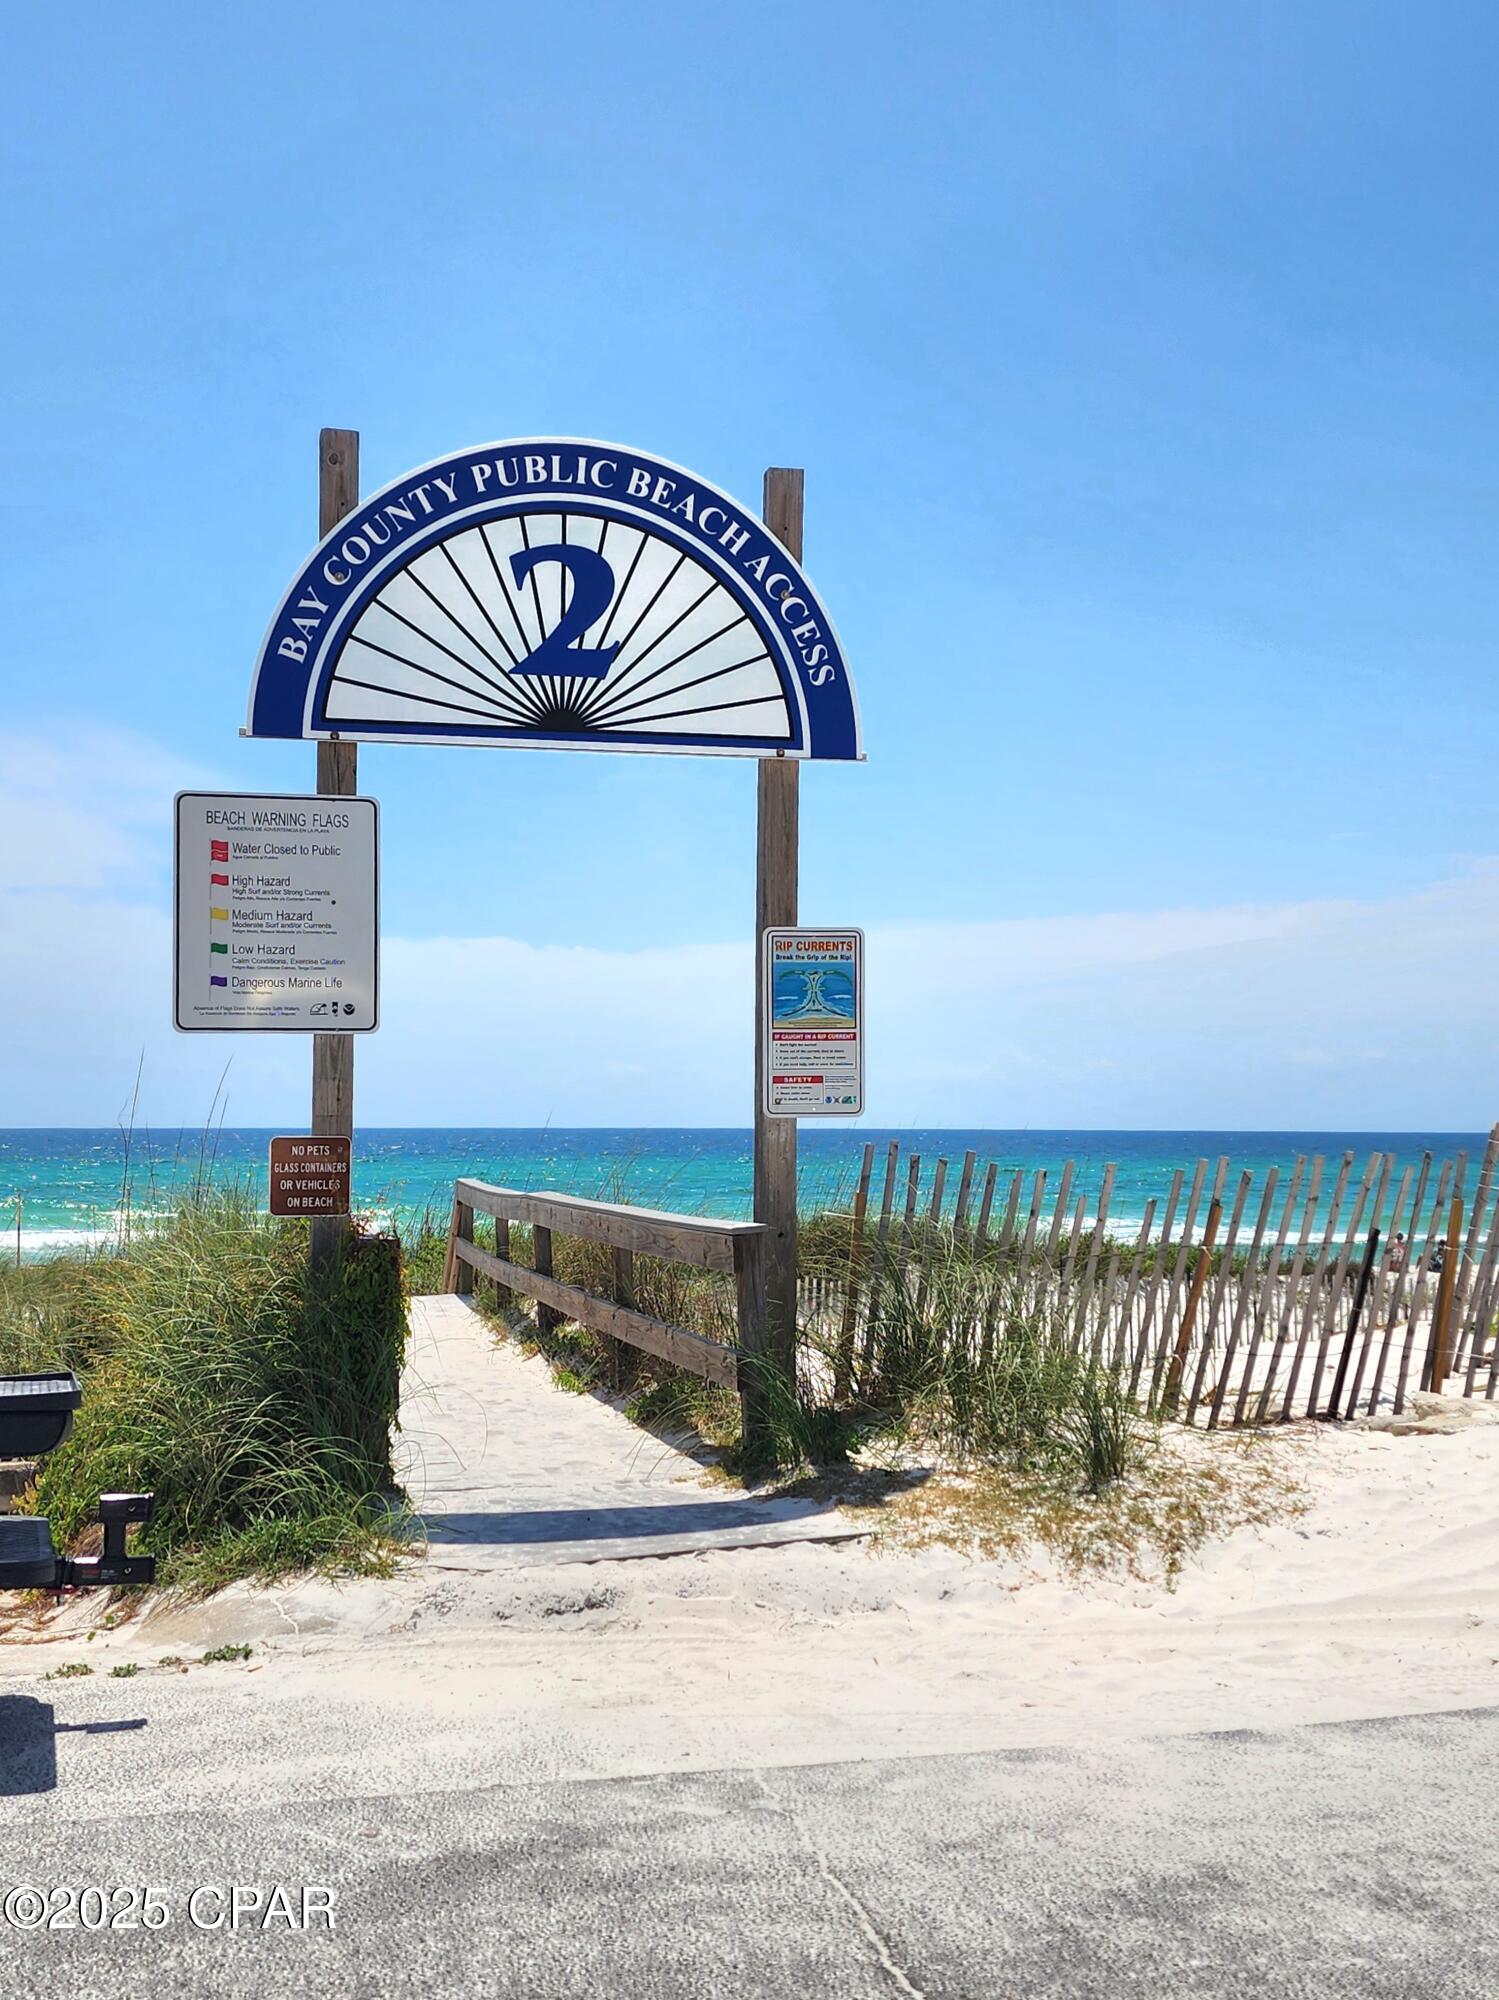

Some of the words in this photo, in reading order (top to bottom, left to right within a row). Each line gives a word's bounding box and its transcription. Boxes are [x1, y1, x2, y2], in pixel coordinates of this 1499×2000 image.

[277, 585, 330, 664] BAY
[323, 472, 458, 586] COUNTY
[471, 455, 617, 494] PUBLIC
[625, 467, 752, 556] BEACH
[743, 555, 836, 687] ACCESS
[508, 543, 620, 680] 2
[206, 810, 246, 825] BEACH
[251, 811, 307, 828] WARNING
[312, 813, 350, 829] FLAGS
[232, 842, 261, 855] Water
[263, 843, 297, 856] Closed
[300, 844, 309, 855] to
[312, 844, 342, 857] Public
[232, 875, 254, 889] High
[256, 875, 291, 887] Hazard
[232, 887, 247, 896] High
[283, 888, 303, 897] Strong
[232, 909, 273, 921] Medium
[276, 910, 313, 922] Hazard
[232, 921, 264, 929] Moderate
[280, 922, 302, 930] and/or
[303, 922, 332, 930] Currents
[232, 943, 254, 955] Low
[257, 944, 296, 955] Hazard
[775, 940, 793, 952] RIP
[796, 940, 853, 952] CURRENTS
[319, 958, 346, 966] Caution
[231, 976, 286, 991] Dangerous
[288, 977, 322, 989] Marine
[324, 977, 343, 989] Life
[291, 1145, 305, 1156] NO
[306, 1145, 330, 1156] PETS
[274, 1162, 299, 1173] GLASS
[300, 1162, 347, 1173] CONTAINERS
[280, 1180, 293, 1190] OR
[295, 1179, 341, 1190] VEHICLES
[287, 1197, 300, 1207] ON
[302, 1197, 333, 1207] BEACH
